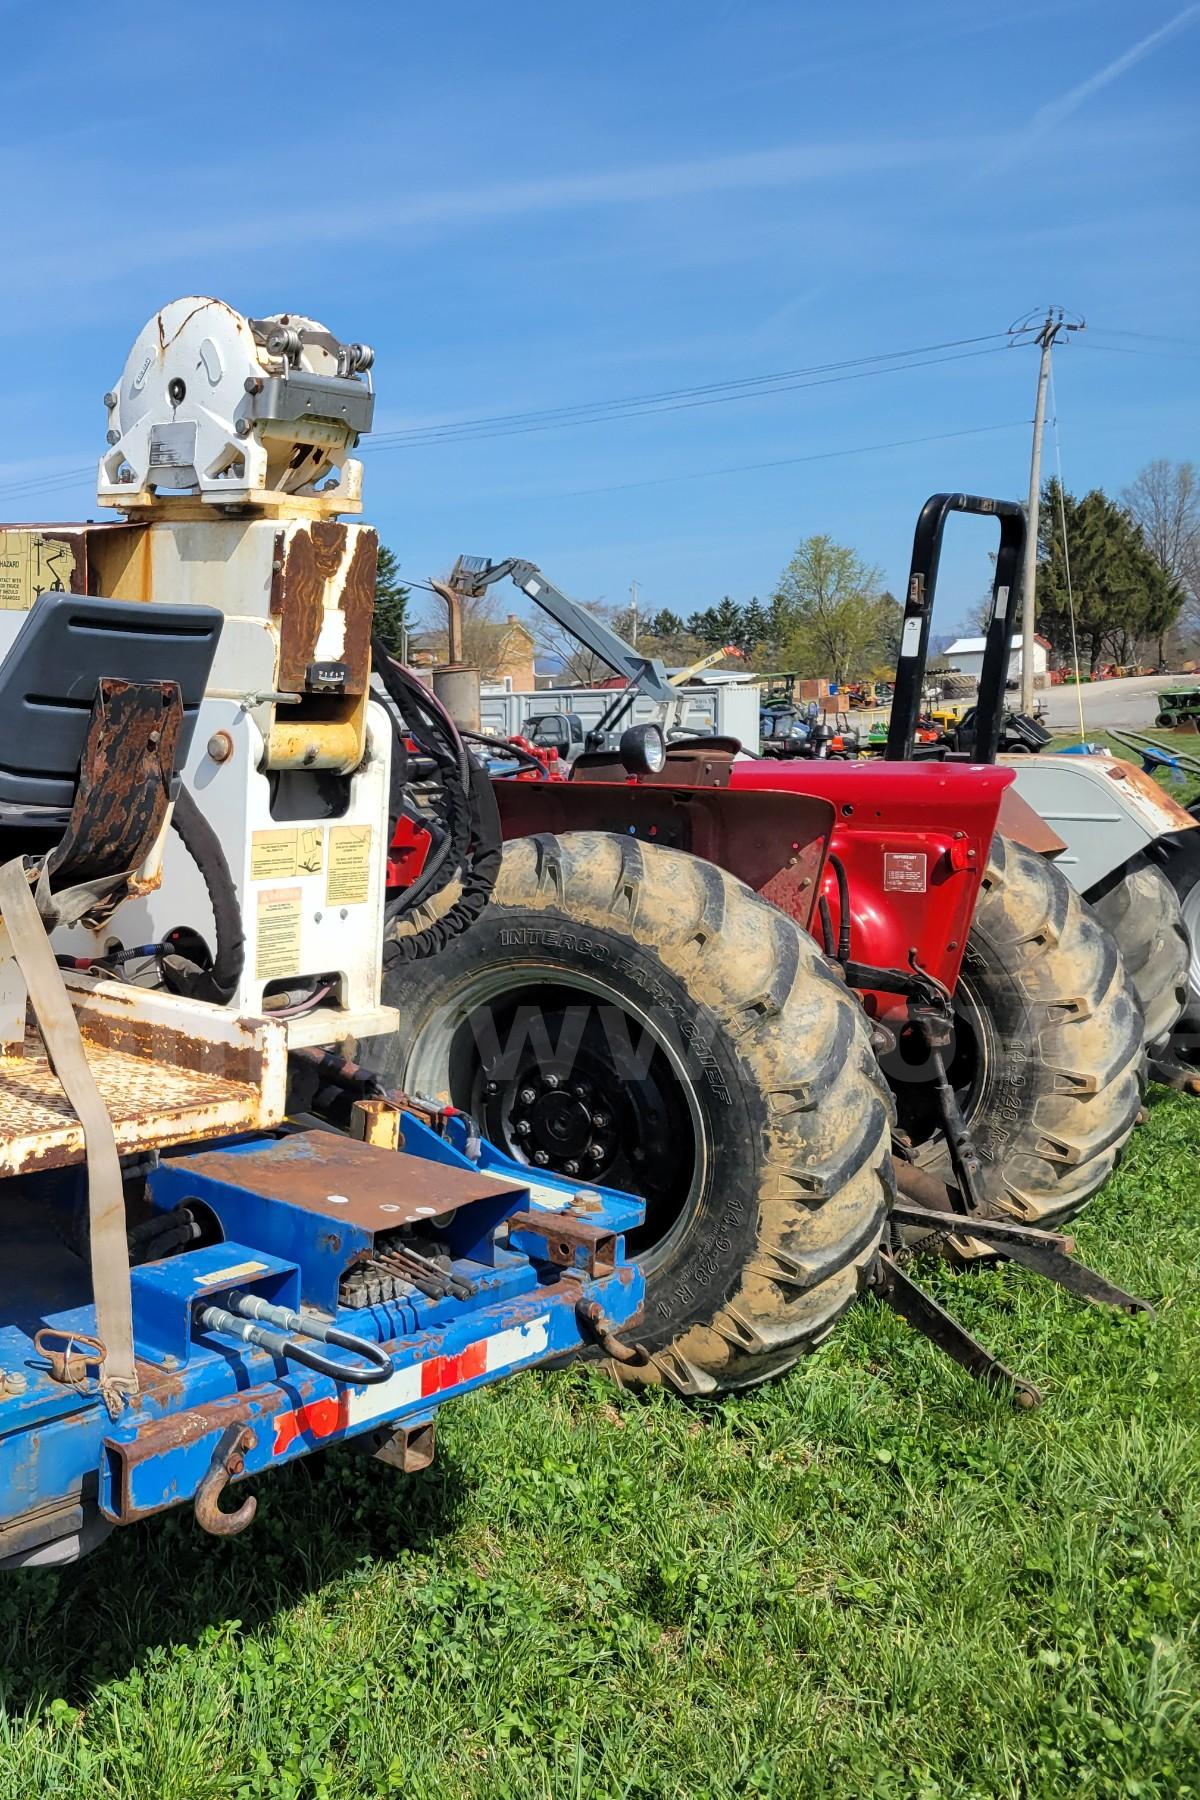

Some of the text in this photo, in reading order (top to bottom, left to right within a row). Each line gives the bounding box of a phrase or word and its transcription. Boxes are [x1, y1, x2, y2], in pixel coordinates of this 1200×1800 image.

[499, 928, 733, 1106] INTERCO FARM CHIEF
